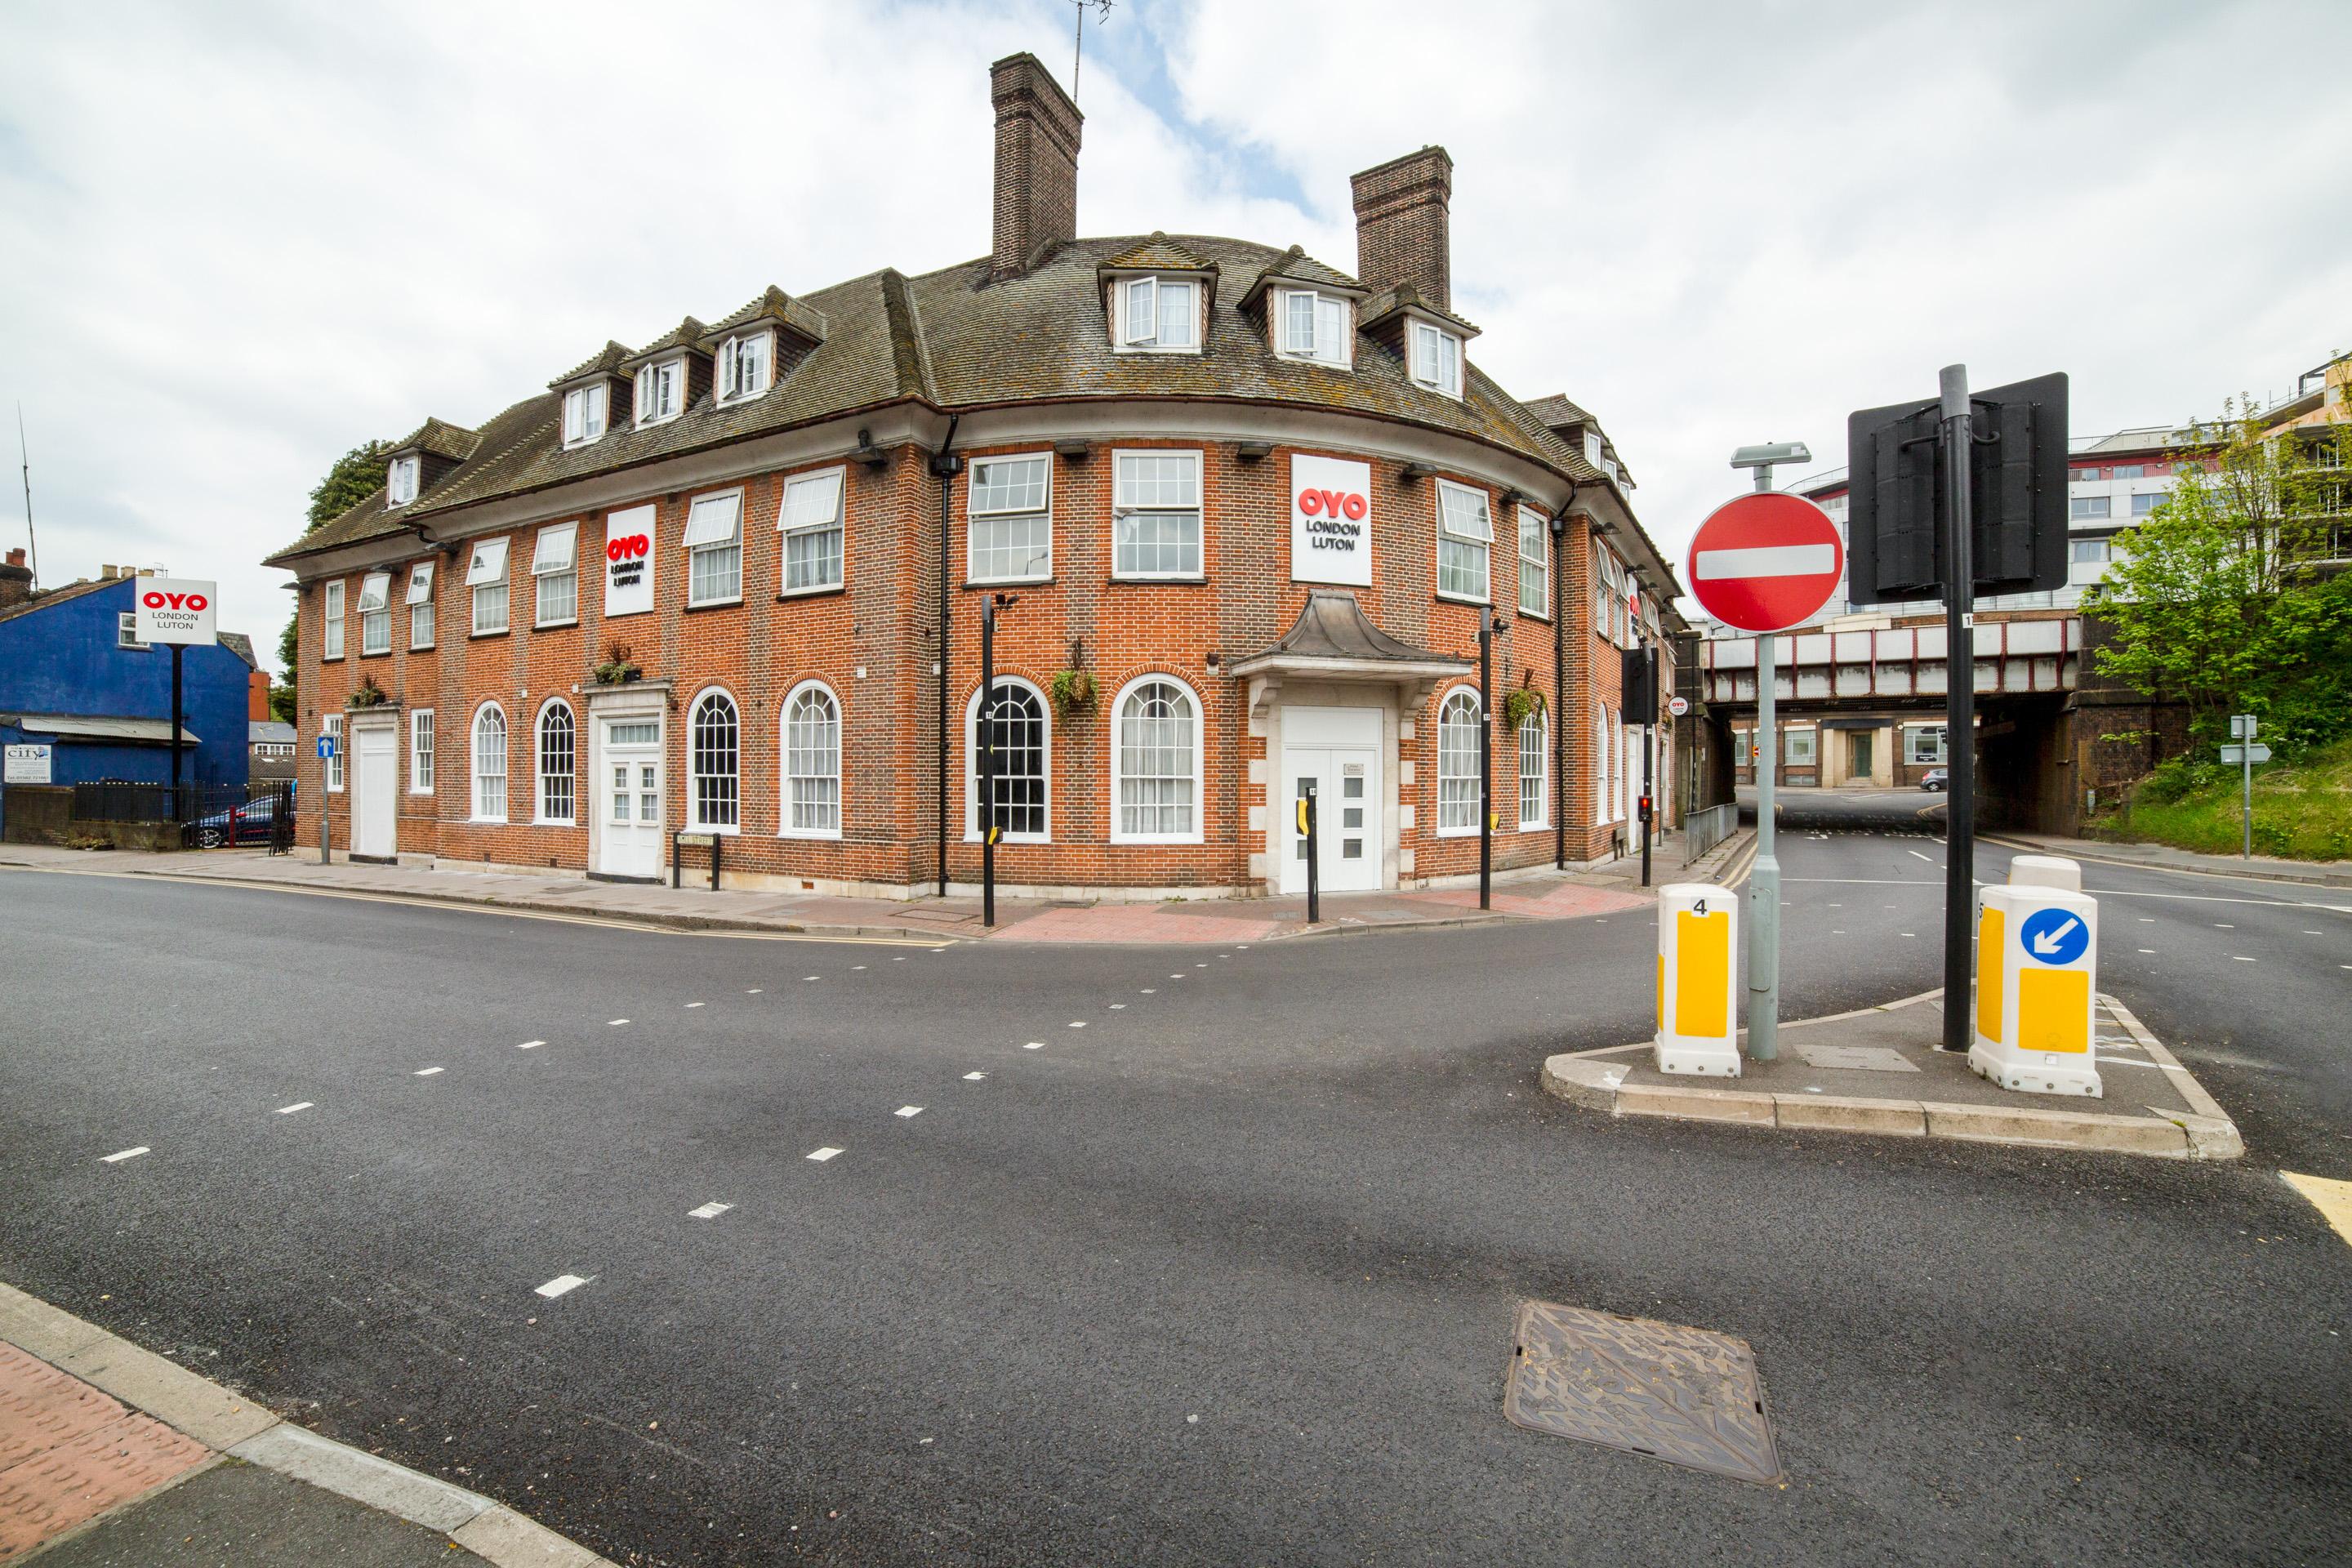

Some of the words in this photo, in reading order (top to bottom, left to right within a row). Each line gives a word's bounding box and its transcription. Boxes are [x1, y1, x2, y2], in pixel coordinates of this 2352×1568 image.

[1298, 488, 1367, 520] OYO
[1306, 519, 1361, 536] LONDON
[607, 533, 649, 561] OYO
[1312, 536, 1355, 551] LUTON
[610, 560, 644, 574] LONDON
[613, 574, 640, 586] LUTON
[143, 591, 208, 612] OYO
[152, 612, 198, 621] LONDON
[157, 621, 194, 630] LUTON
[1693, 899, 1707, 915] 4
[1978, 902, 1984, 919] 5
